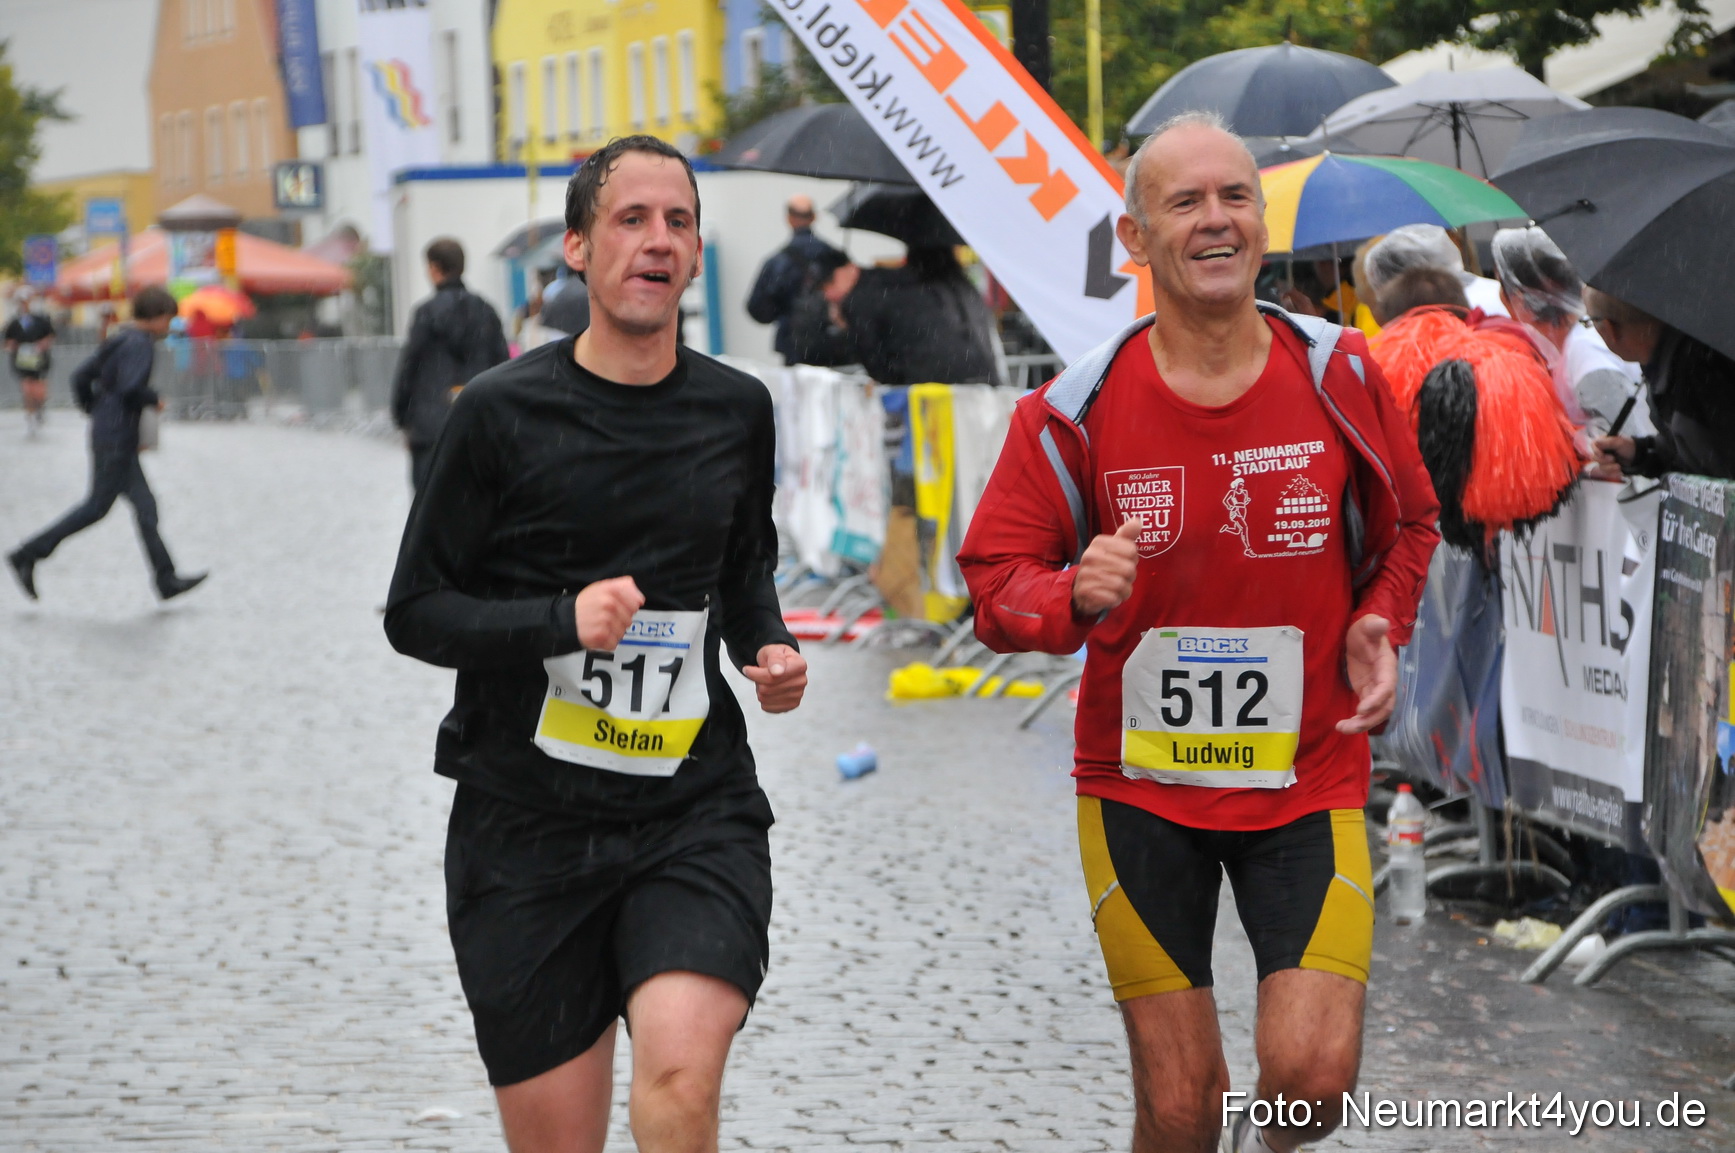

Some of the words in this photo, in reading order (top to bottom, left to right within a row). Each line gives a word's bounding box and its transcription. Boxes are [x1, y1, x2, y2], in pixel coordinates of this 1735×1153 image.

[1212, 454, 1232, 466] 11.
[1234, 440, 1325, 463] NEUMARKTER
[1232, 456, 1311, 477] STADTLAUF
[1117, 480, 1172, 496] IMMER
[1116, 495, 1174, 509] WIEDER
[1274, 517, 1330, 530] 19.09.2010
[1135, 530, 1170, 543] ARKT
[625, 620, 675, 637] OCK
[1178, 637, 1248, 653] BOCK
[581, 650, 684, 713] 511
[1161, 669, 1268, 727] 512
[1130, 717, 1137, 728] D
[594, 719, 663, 751] Stefan
[1172, 741, 1254, 769] Ludwig
